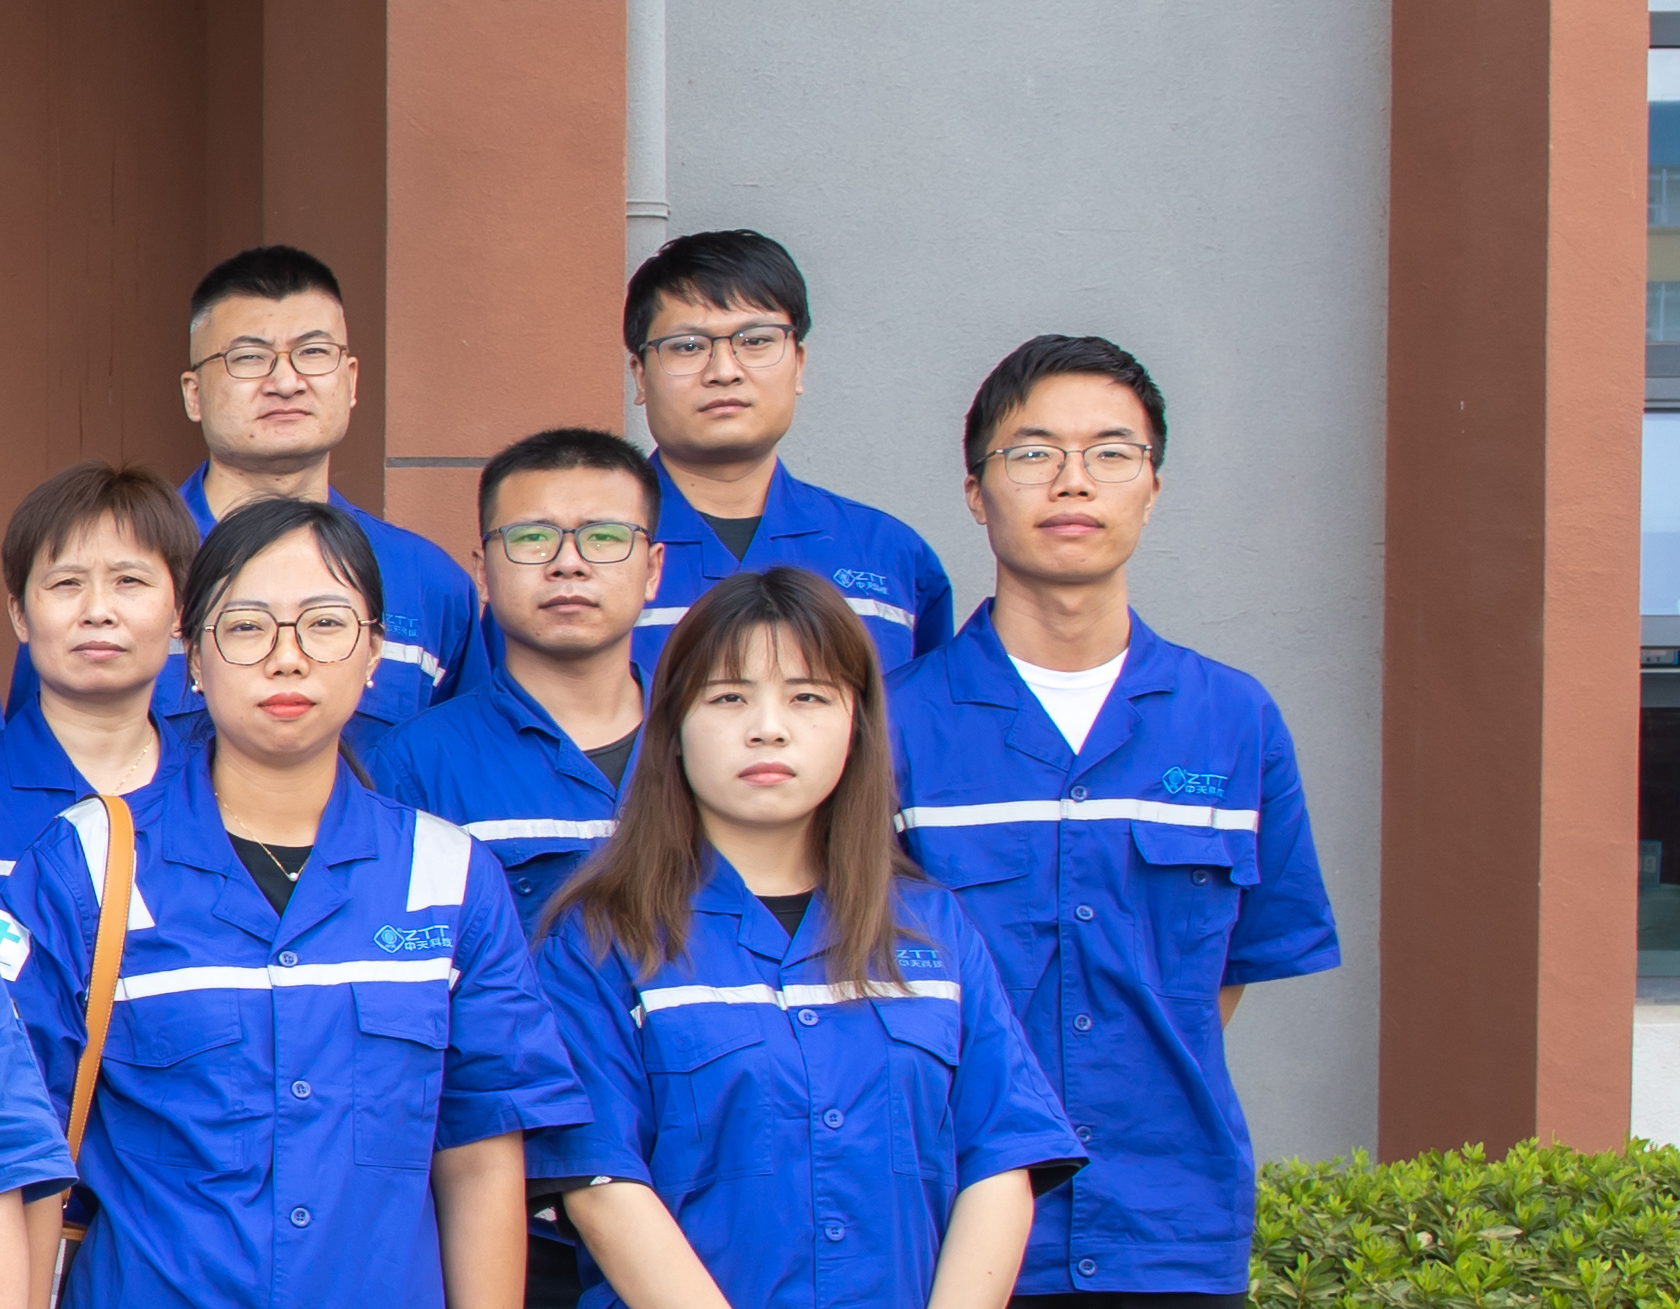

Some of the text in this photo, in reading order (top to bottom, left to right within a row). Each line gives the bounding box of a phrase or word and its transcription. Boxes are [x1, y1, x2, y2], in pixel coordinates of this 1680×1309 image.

[853, 571, 887, 586] ZTT
[1188, 773, 1229, 787] ZTT
[405, 924, 449, 940] ZTT
[896, 949, 939, 959] ZTT
